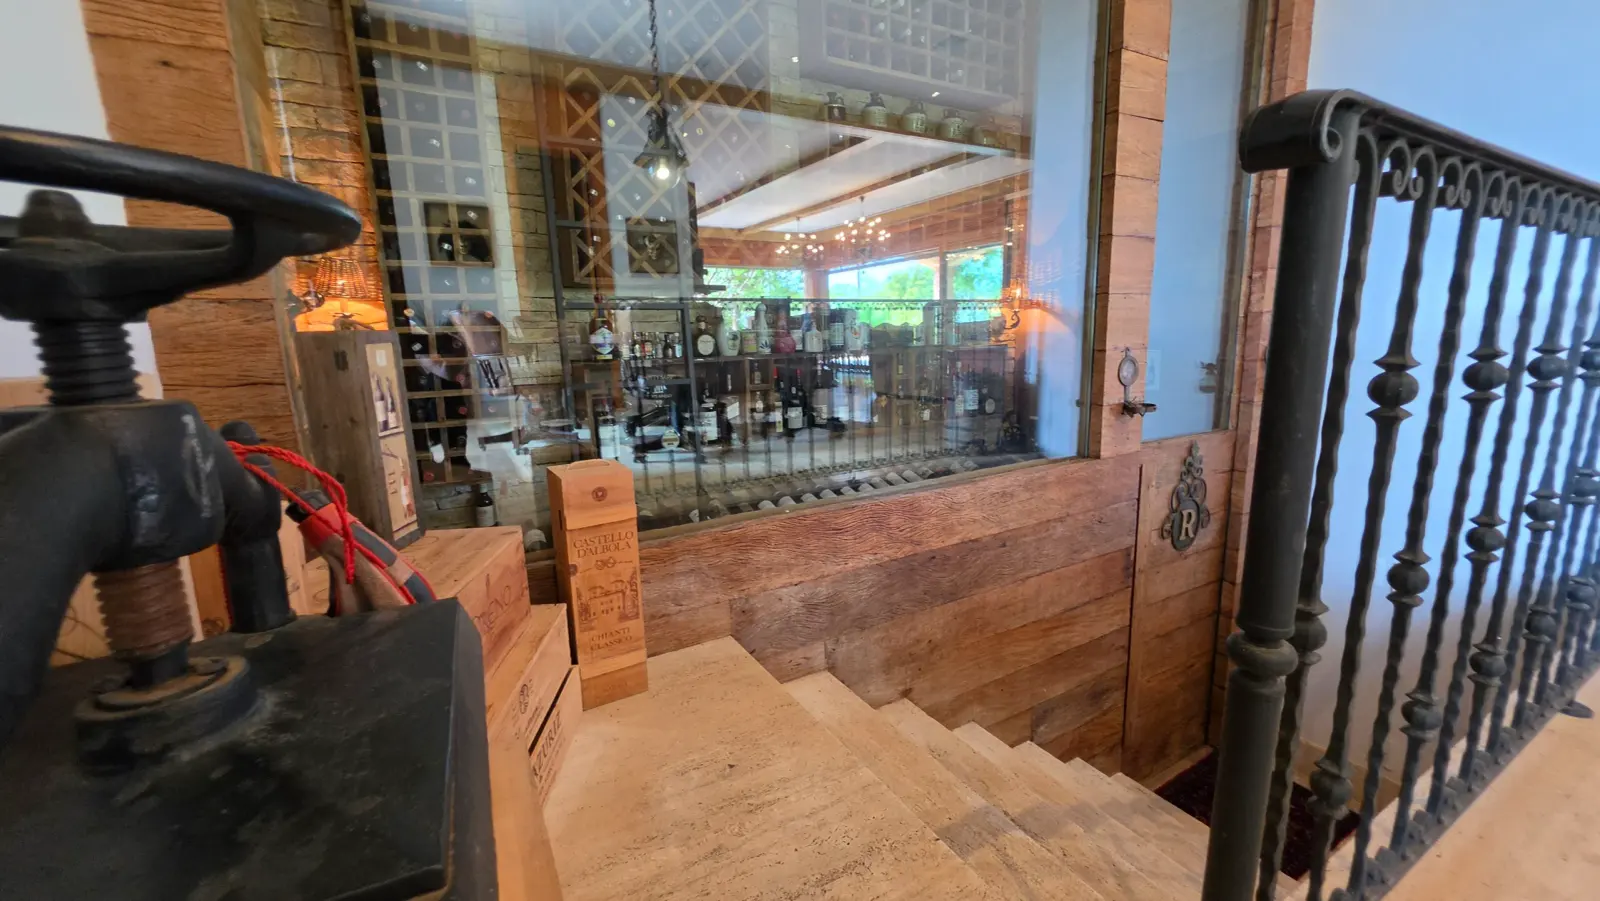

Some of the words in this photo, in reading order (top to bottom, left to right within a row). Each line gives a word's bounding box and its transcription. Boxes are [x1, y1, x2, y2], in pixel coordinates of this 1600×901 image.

[1179, 508, 1197, 541] R
[573, 530, 634, 549] CASTELLO
[576, 540, 632, 558] D'ALBOLA
[590, 636, 633, 651] CLASSICO
[591, 627, 630, 642] CHIANTI
